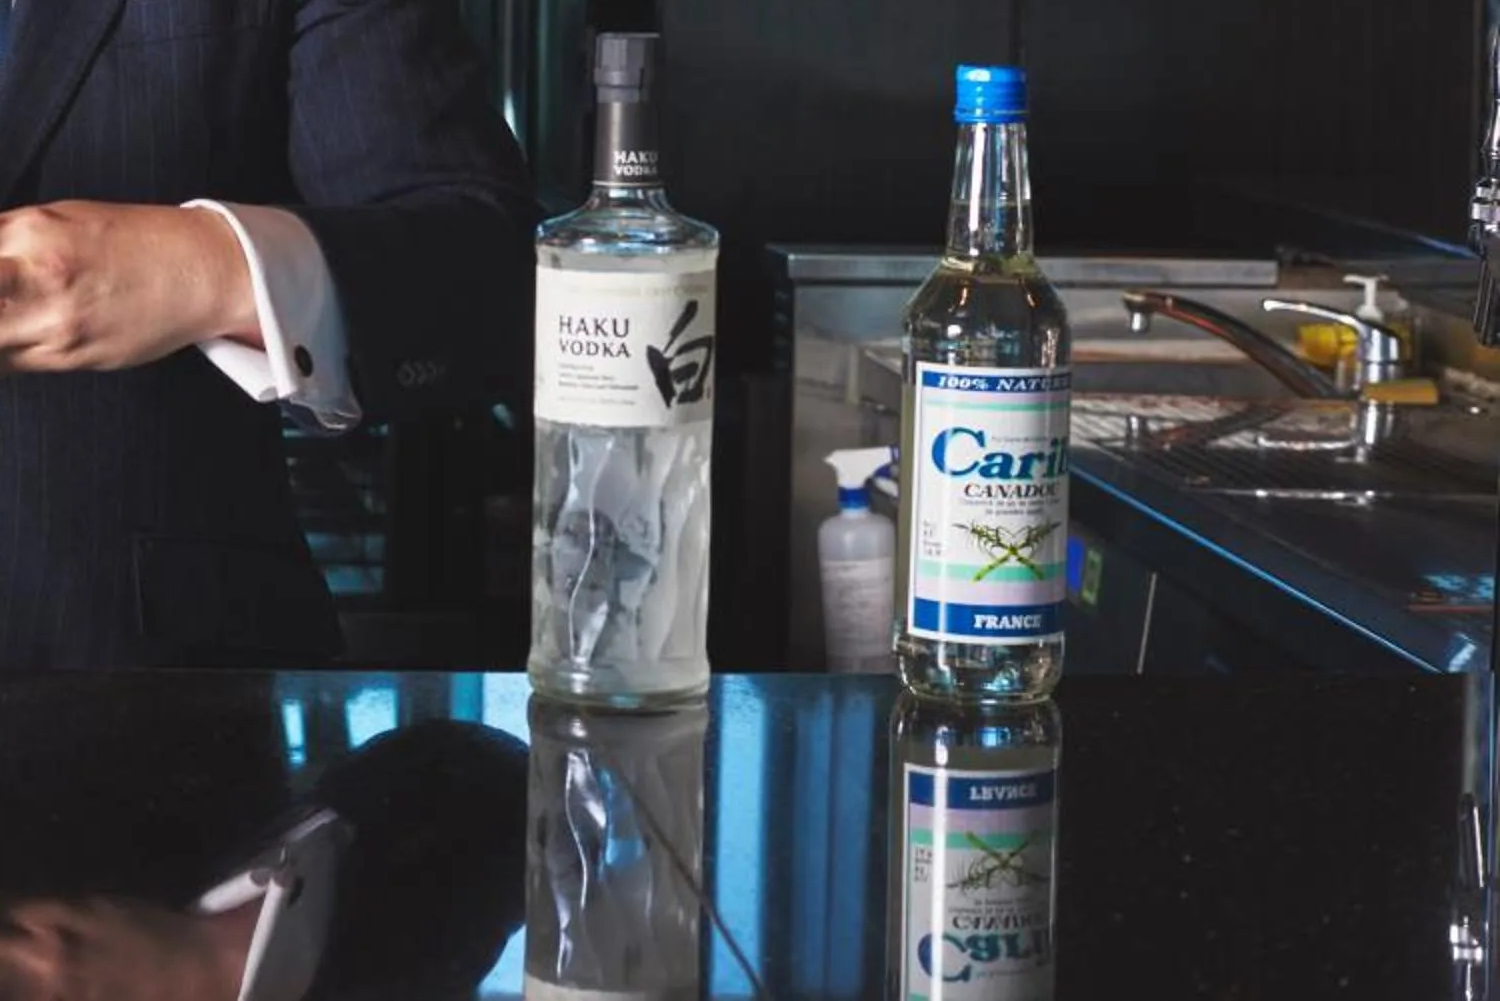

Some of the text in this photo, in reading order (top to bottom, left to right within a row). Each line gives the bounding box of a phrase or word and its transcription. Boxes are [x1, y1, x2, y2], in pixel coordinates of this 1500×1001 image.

[613, 151, 659, 164] HAKU
[613, 165, 657, 176] VODKA
[559, 315, 630, 339] HAKU
[559, 339, 631, 359] VODKA
[646, 300, 714, 410] 白
[938, 376, 989, 390] 100%
[973, 614, 1041, 630] FRANCE
